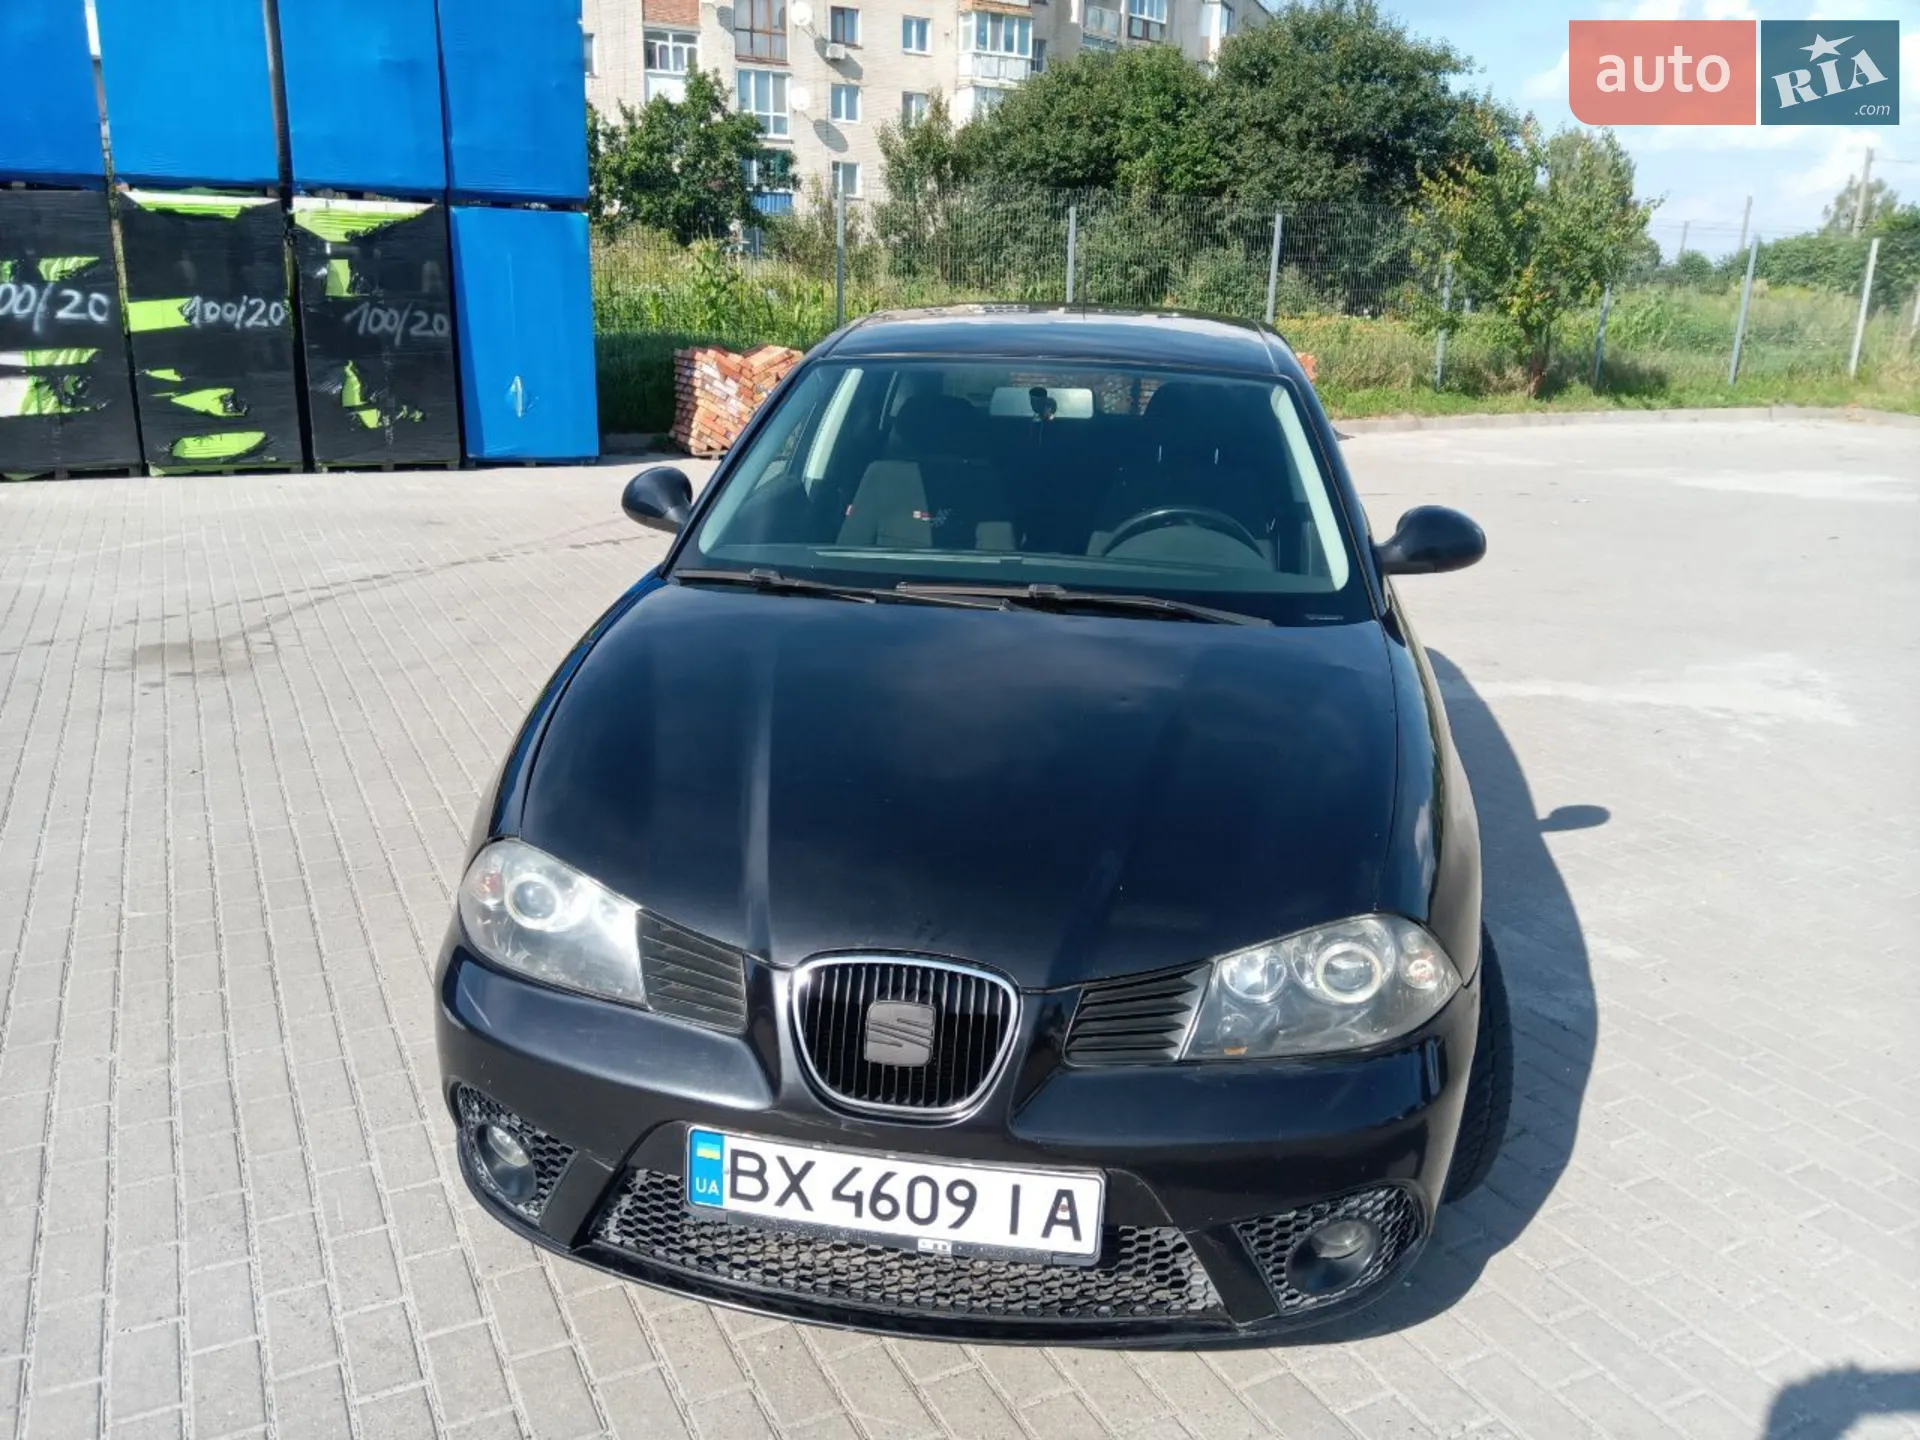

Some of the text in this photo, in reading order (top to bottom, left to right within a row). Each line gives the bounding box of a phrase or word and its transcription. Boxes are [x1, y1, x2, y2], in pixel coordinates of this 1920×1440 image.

[182, 295, 286, 330] 100/20
[344, 302, 451, 346] 100/20
[695, 1177, 720, 1196] UA
[729, 1148, 816, 1212] BX
[832, 1167, 978, 1229] 4609
